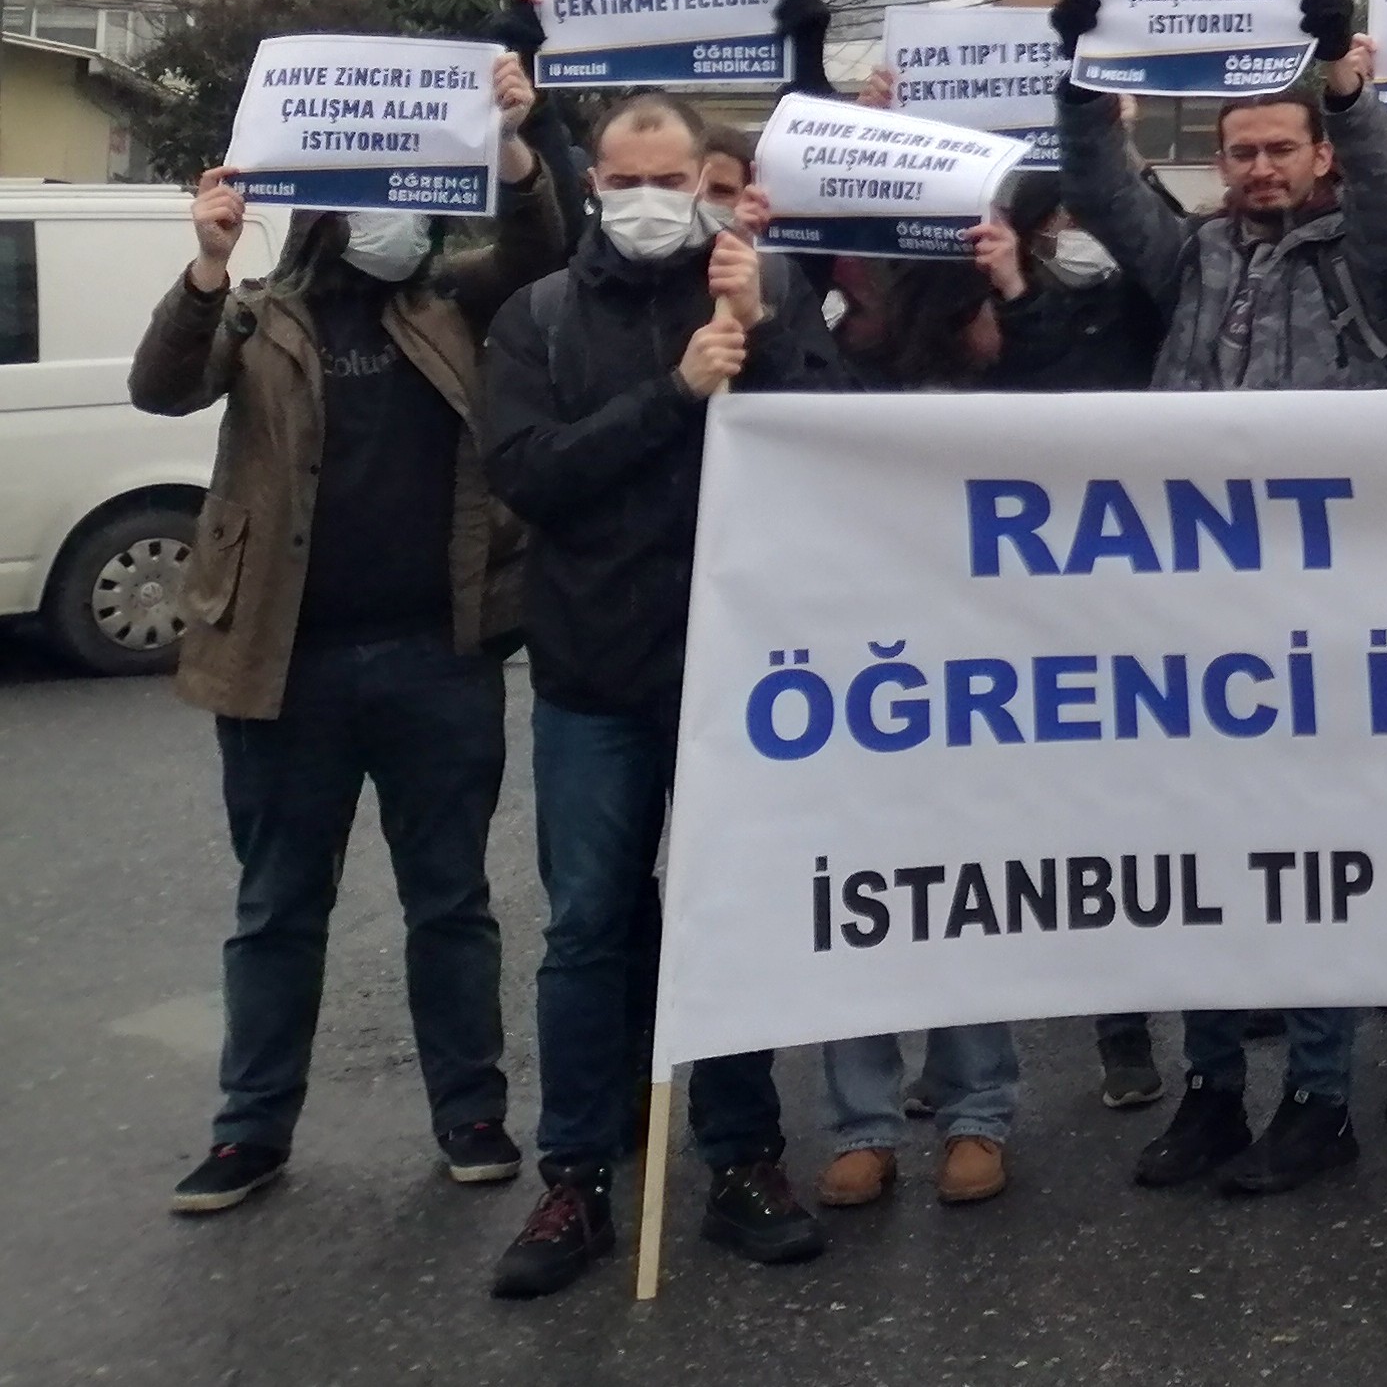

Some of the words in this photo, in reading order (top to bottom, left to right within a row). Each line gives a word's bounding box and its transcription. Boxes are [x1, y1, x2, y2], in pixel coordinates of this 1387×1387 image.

[693, 45, 776, 60] ÖĞRENCİ
[897, 46, 950, 74] ÇAPA
[1224, 53, 1301, 71] ÖĞRENCİ
[263, 66, 328, 87] KAHVE
[693, 59, 777, 74] SENDİKASI
[281, 98, 374, 124] ÇALIŞMA
[382, 100, 448, 121] ALANI
[786, 119, 853, 138] KAHVE
[802, 146, 888, 171] ÇALIŞMA
[893, 152, 959, 172] ALANI
[388, 172, 479, 190] ÖĞRENCİ
[388, 189, 478, 205] SENDİKASI
[896, 221, 968, 240] ÖĞRENC
[965, 478, 1354, 577] RANT
[746, 631, 1316, 760] ÖĞRENCİ
[813, 854, 1222, 952] İSTANBUL
[1248, 851, 1373, 924] TIP
